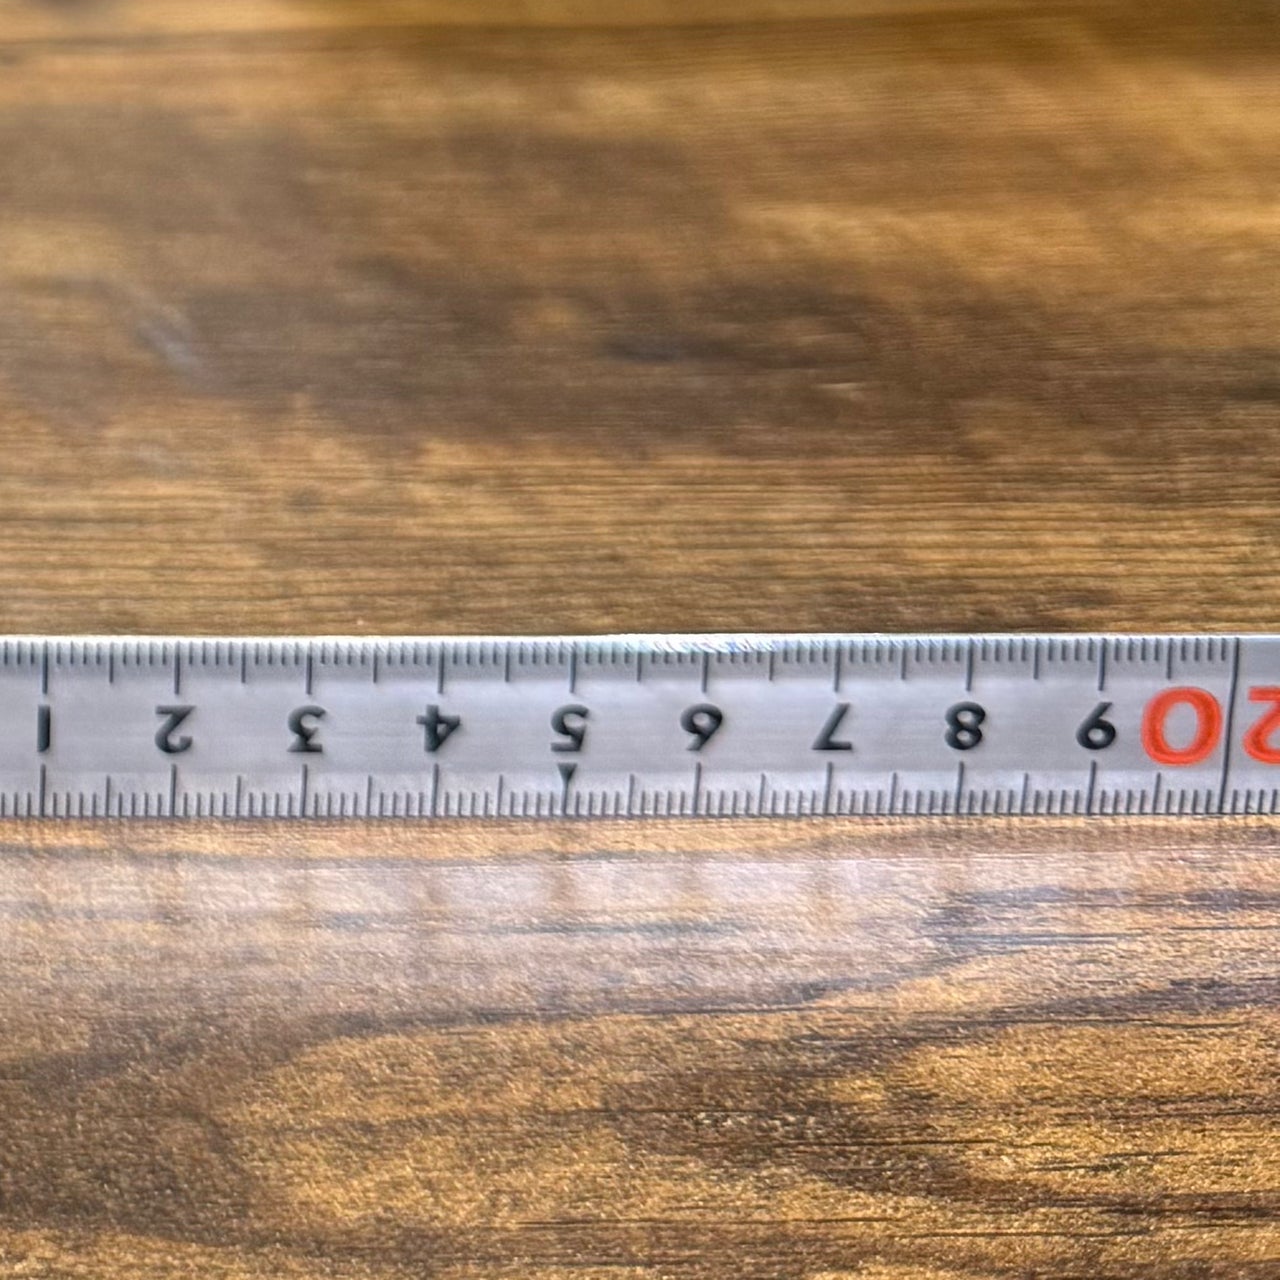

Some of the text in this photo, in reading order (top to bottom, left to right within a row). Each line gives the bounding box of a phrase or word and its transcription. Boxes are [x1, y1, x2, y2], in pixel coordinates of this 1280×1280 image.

[39, 708, 51, 752] 1
[157, 708, 192, 755] 2
[290, 708, 325, 754] 3
[418, 708, 461, 753] 4
[553, 708, 588, 752] 5
[683, 707, 723, 751] 6
[813, 705, 853, 751] 7
[947, 704, 986, 750] 8
[1078, 703, 1116, 750] 9
